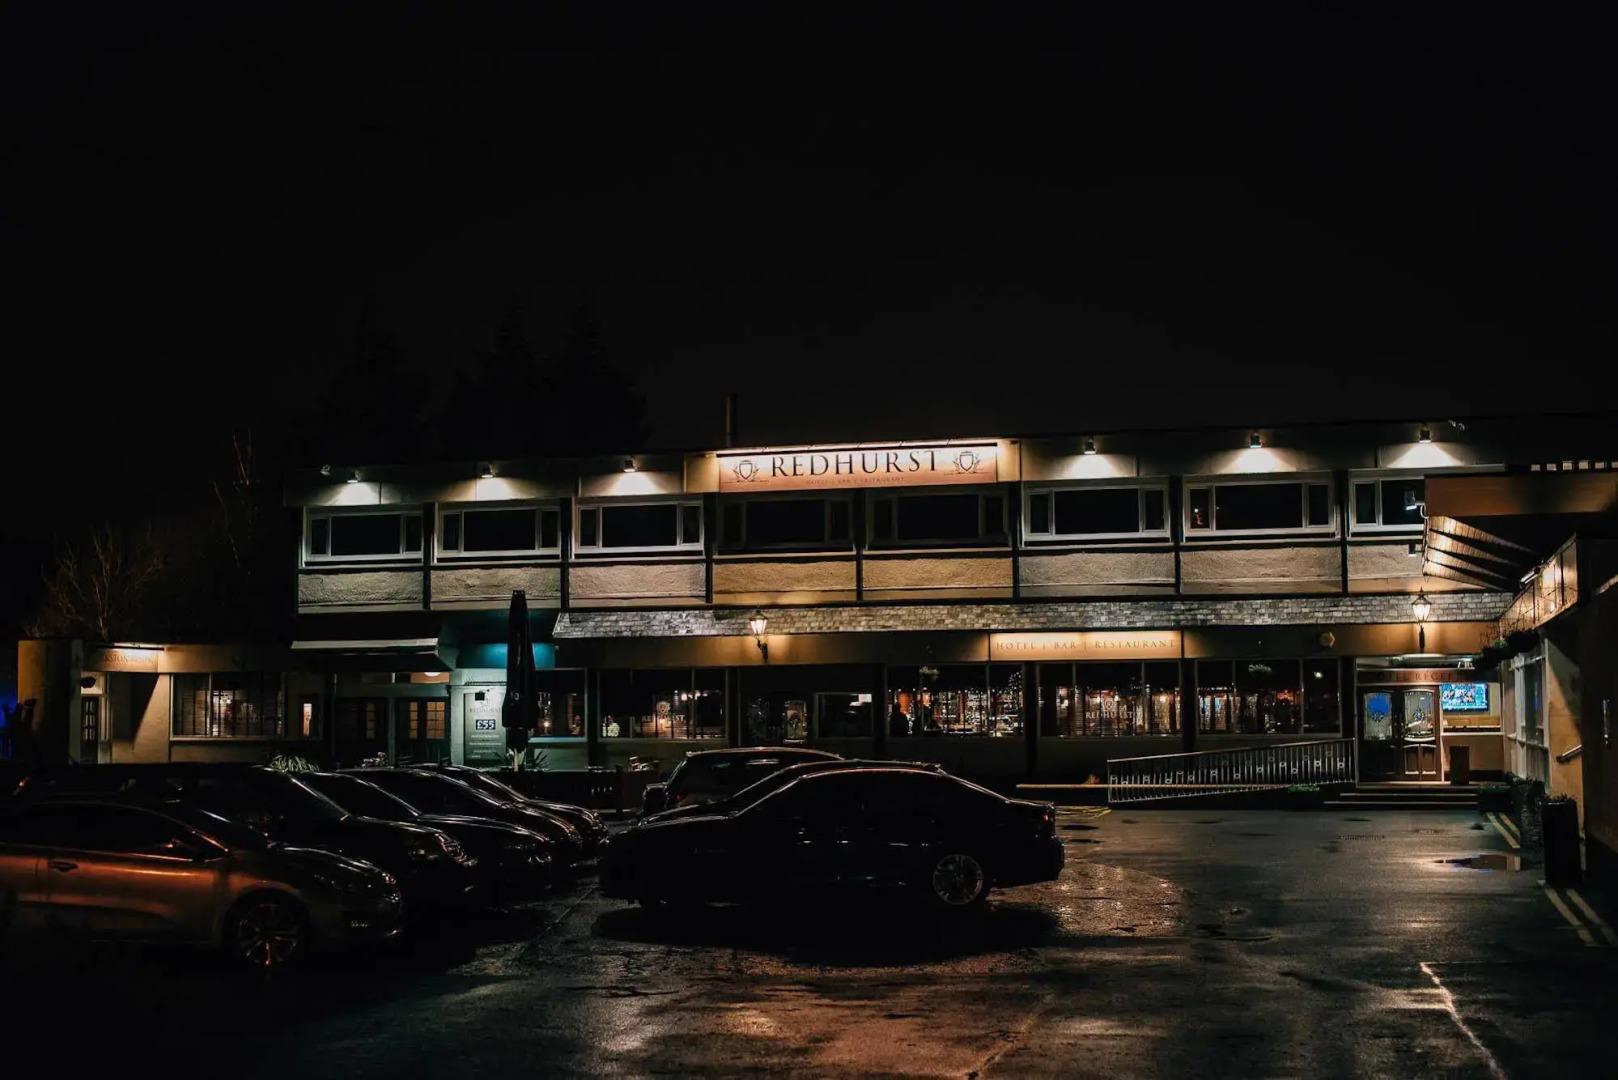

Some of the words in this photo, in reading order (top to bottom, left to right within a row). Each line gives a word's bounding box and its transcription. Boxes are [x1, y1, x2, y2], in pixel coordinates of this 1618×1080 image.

[771, 449, 942, 478] REDHURST
[996, 642, 1035, 651] HOTEL
[1054, 641, 1077, 650] BAR
[1095, 639, 1176, 649] RESTAURANT
[641, 714, 686, 722] RERST
[476, 720, 495, 730] £55
